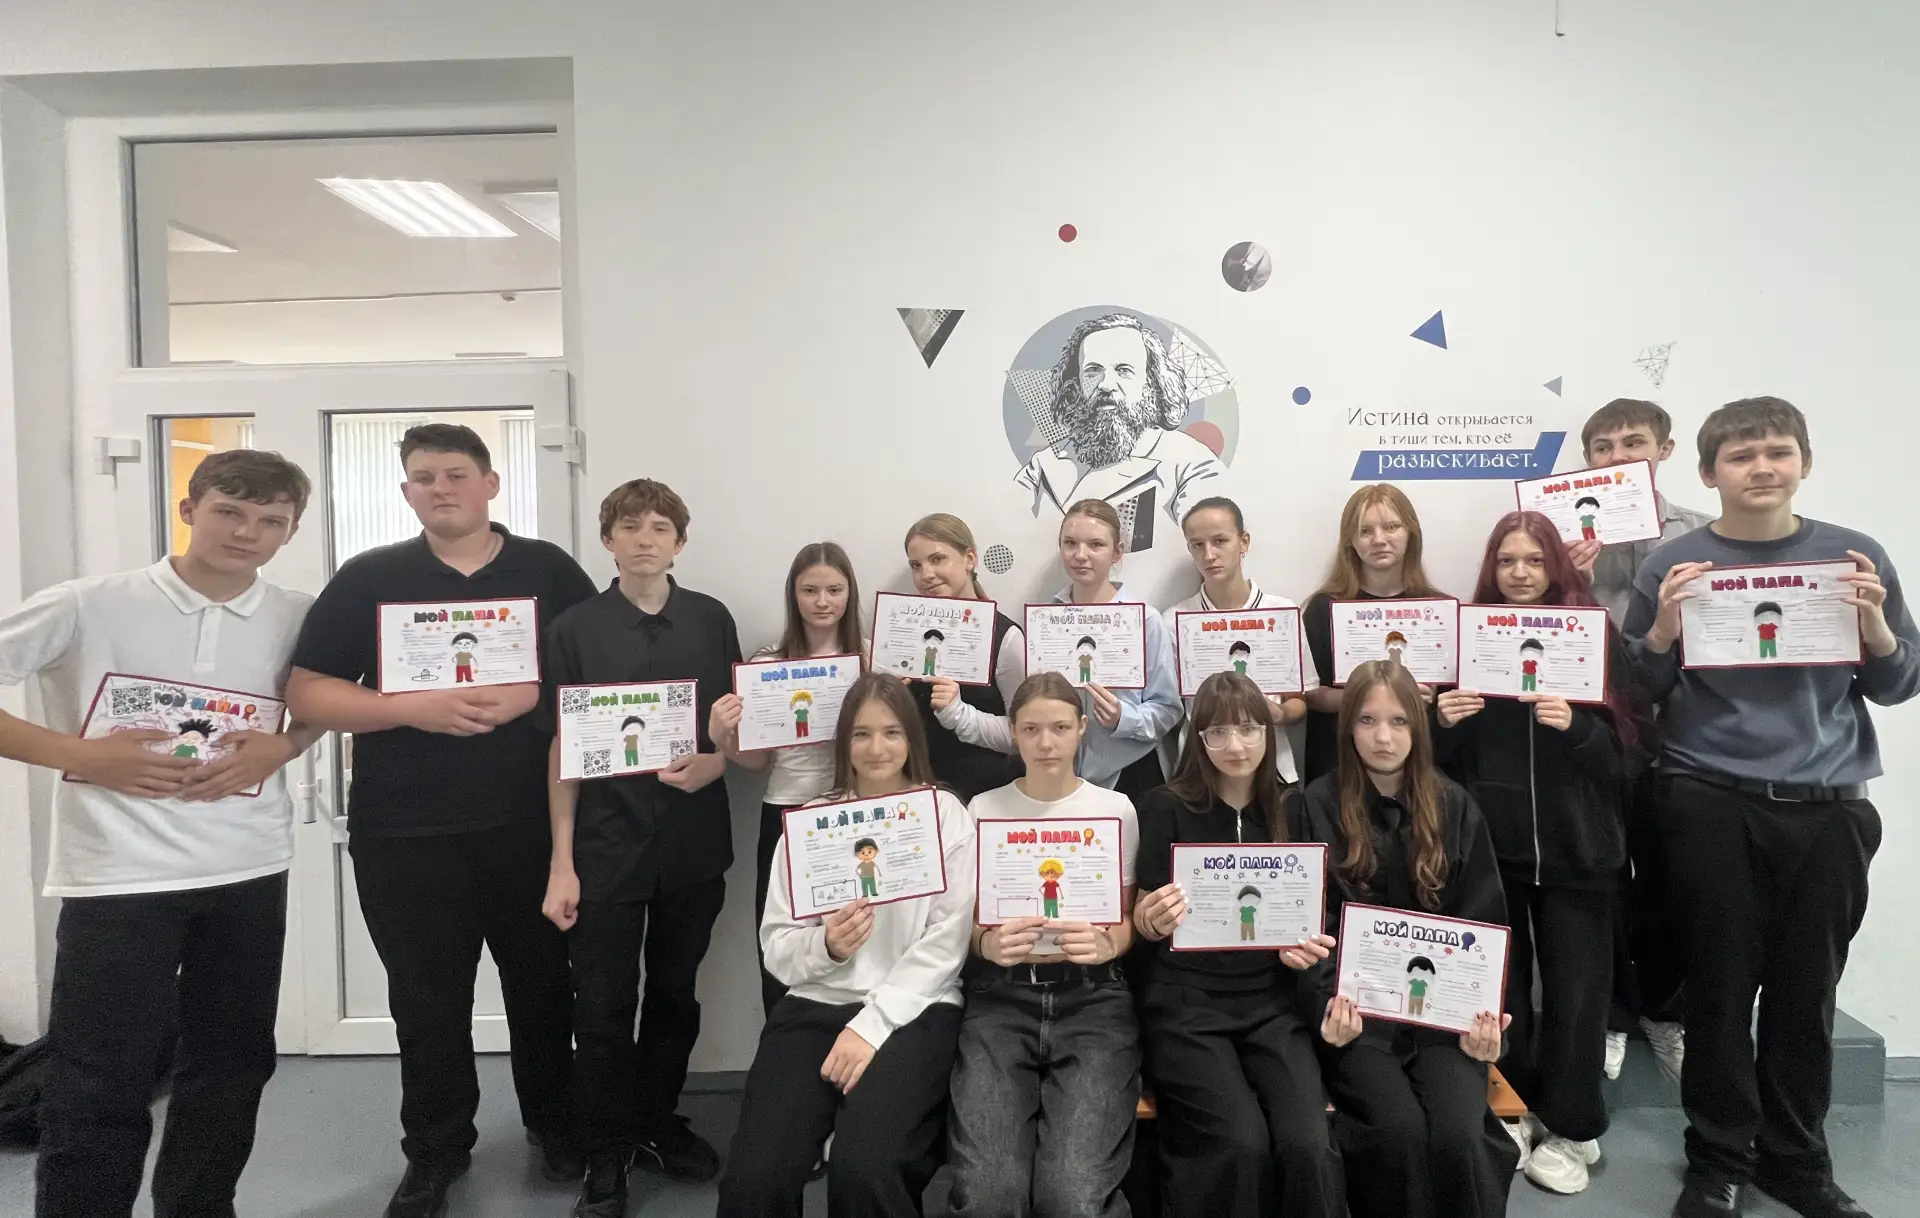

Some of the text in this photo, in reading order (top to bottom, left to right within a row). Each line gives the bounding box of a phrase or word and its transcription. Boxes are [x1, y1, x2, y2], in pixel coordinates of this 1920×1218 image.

[1348, 407, 1533, 428] Истина открывается
[1379, 435, 1386, 445] в
[1392, 435, 1427, 445] тиши
[1466, 434, 1491, 445] кто
[1494, 432, 1512, 445] её
[1377, 452, 1538, 475] разыскивает.
[1543, 475, 1612, 494] МОЙ ПАПА
[1711, 575, 1804, 591] МОЙ ПАПА
[414, 609, 496, 623] МОЙ ПАПА
[1487, 613, 1564, 628] МОЙ ПАПА
[1202, 618, 1265, 632] МОЙ ПАПА
[761, 666, 827, 682] МОЙ ПАПА
[591, 692, 661, 707] МОЙ ПАПА
[1007, 828, 1081, 844] МОЙ ПАПА
[1204, 854, 1283, 870] МОЙ ПАПА
[1373, 920, 1459, 946] МОЙ ПАПА
